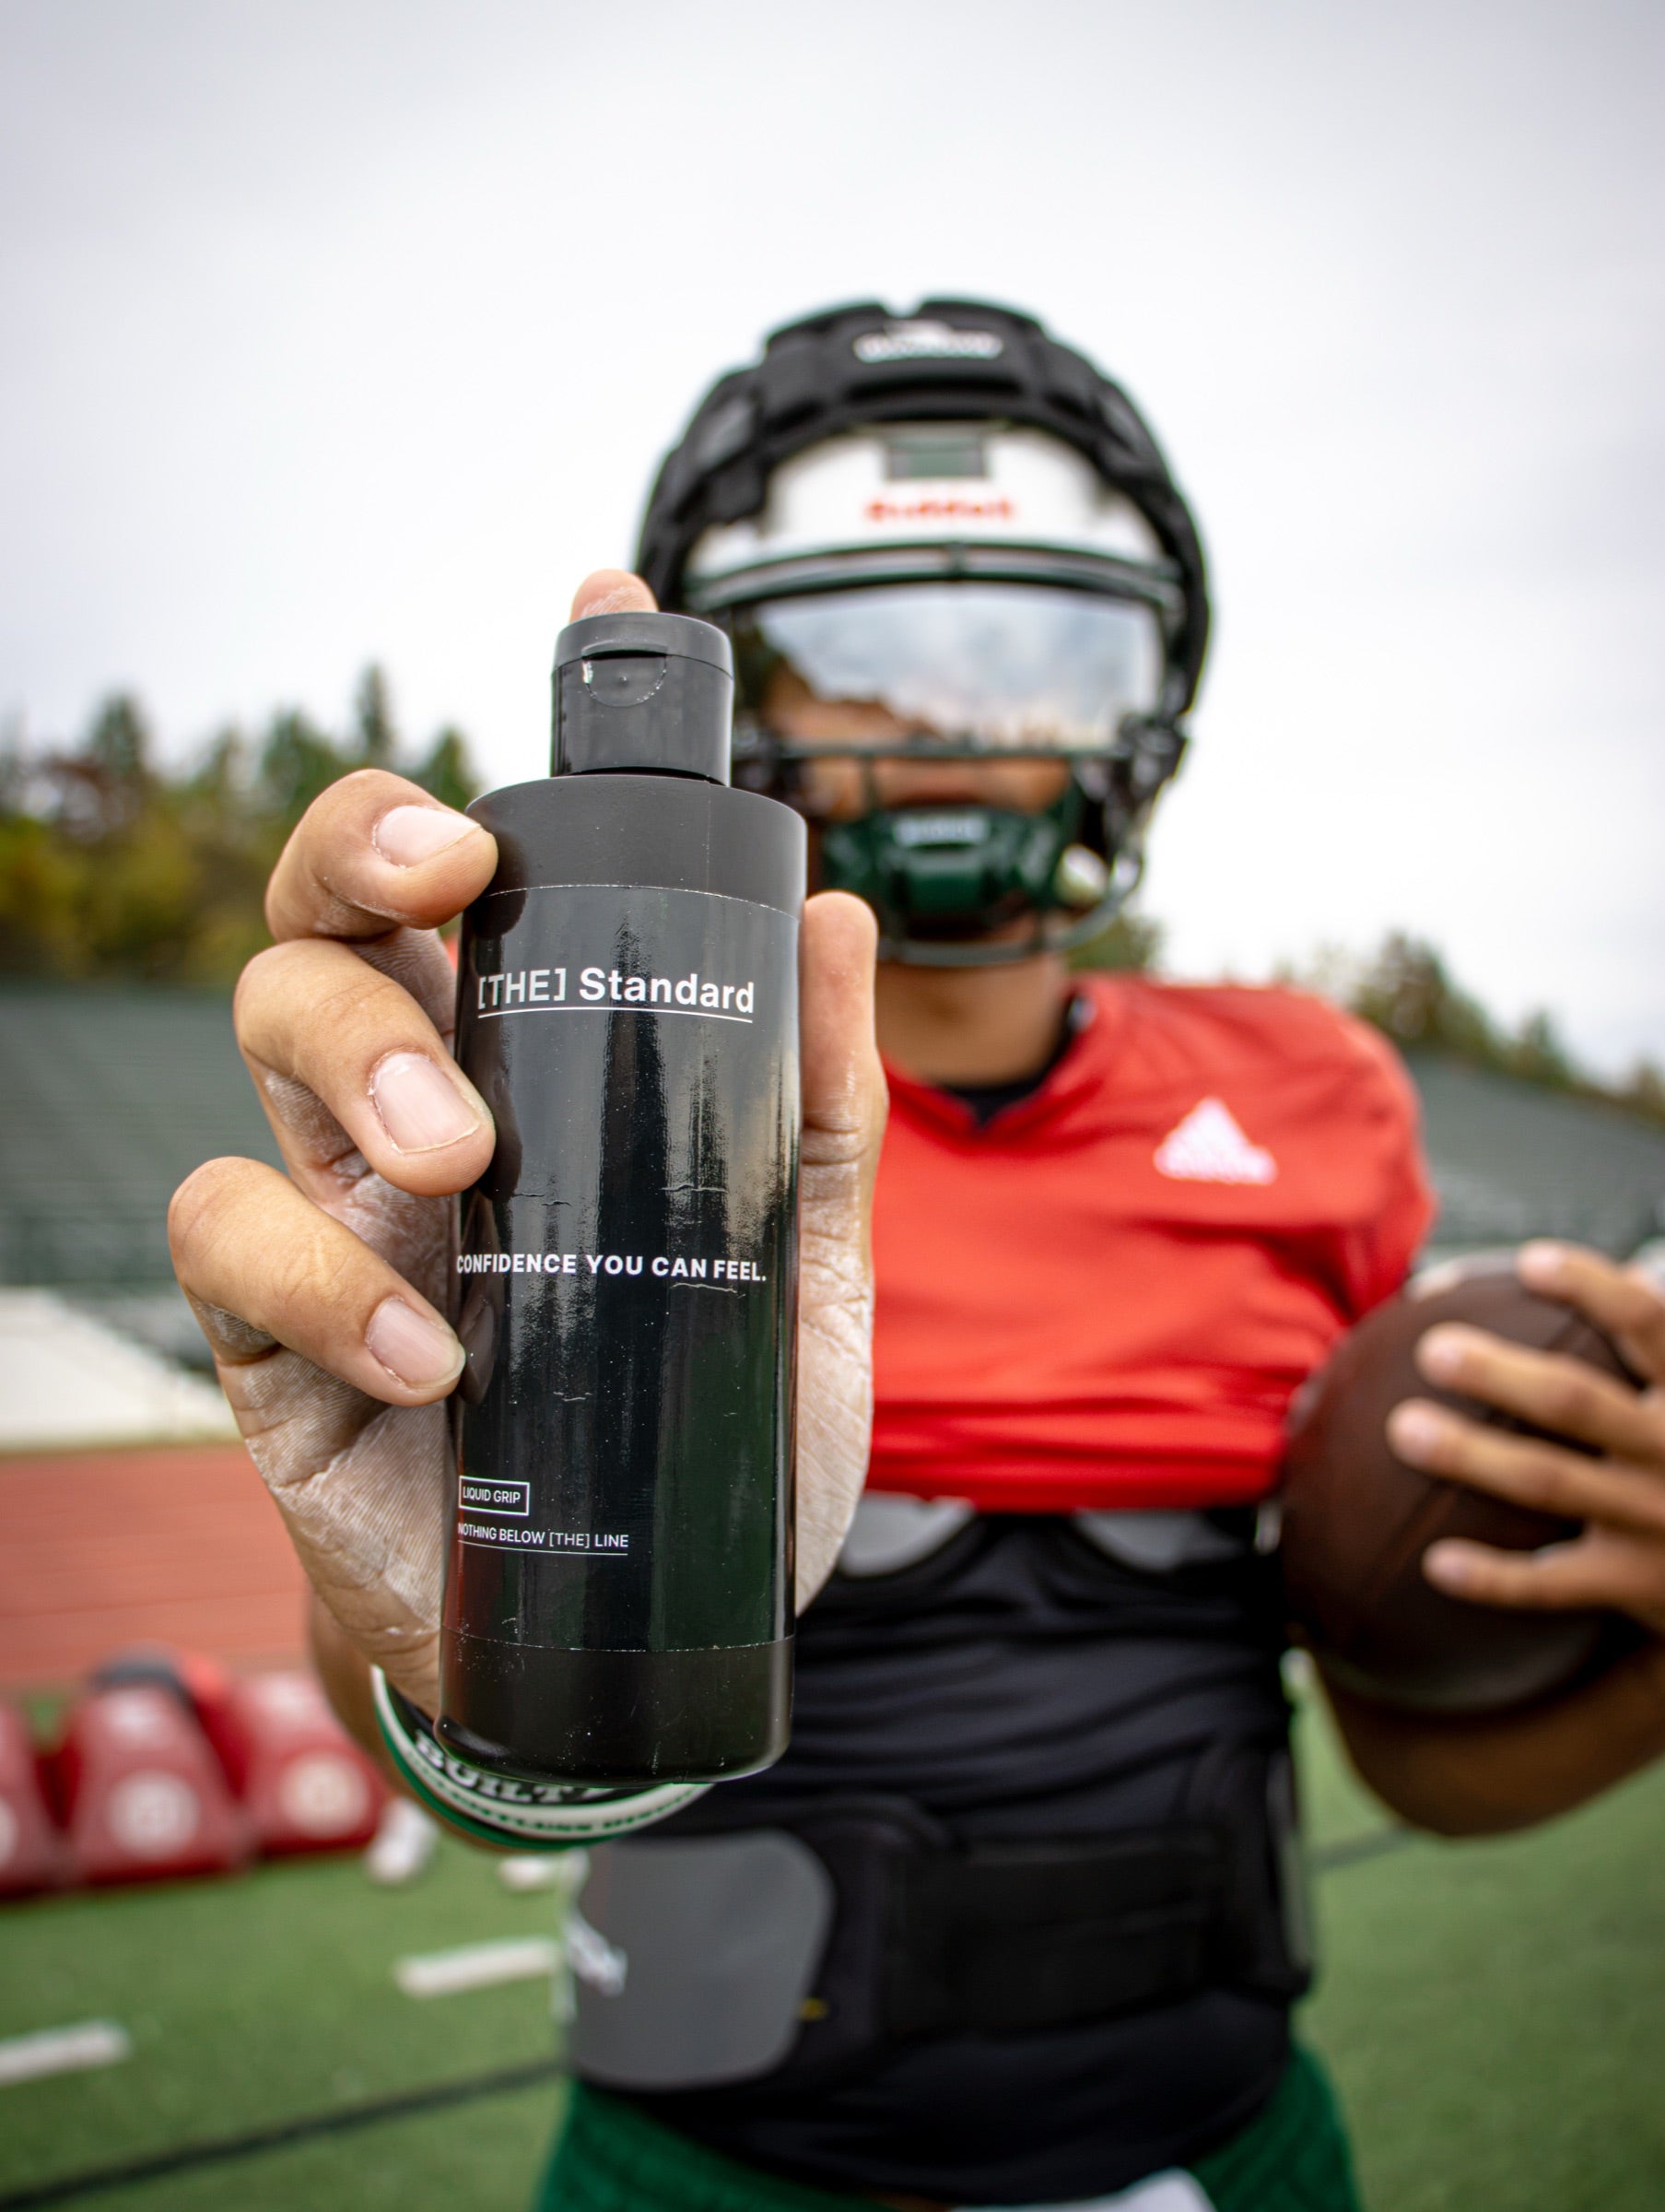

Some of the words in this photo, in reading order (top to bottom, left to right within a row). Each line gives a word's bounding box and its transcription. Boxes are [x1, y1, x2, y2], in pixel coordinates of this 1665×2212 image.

[477, 967, 568, 1010] [THE]
[579, 967, 755, 1014] Standard
[456, 1253, 578, 1274] CONFIDENCE
[586, 1254, 644, 1276] YOU
[651, 1256, 707, 1277] CAN
[713, 1259, 767, 1282] FEEL.
[462, 1486, 492, 1503] LIQUID
[493, 1489, 522, 1504] GRIP
[458, 1522, 498, 1541] NOTHING
[498, 1527, 546, 1545] BELOW
[548, 1531, 591, 1549] [THE]
[594, 1533, 629, 1548] LINE
